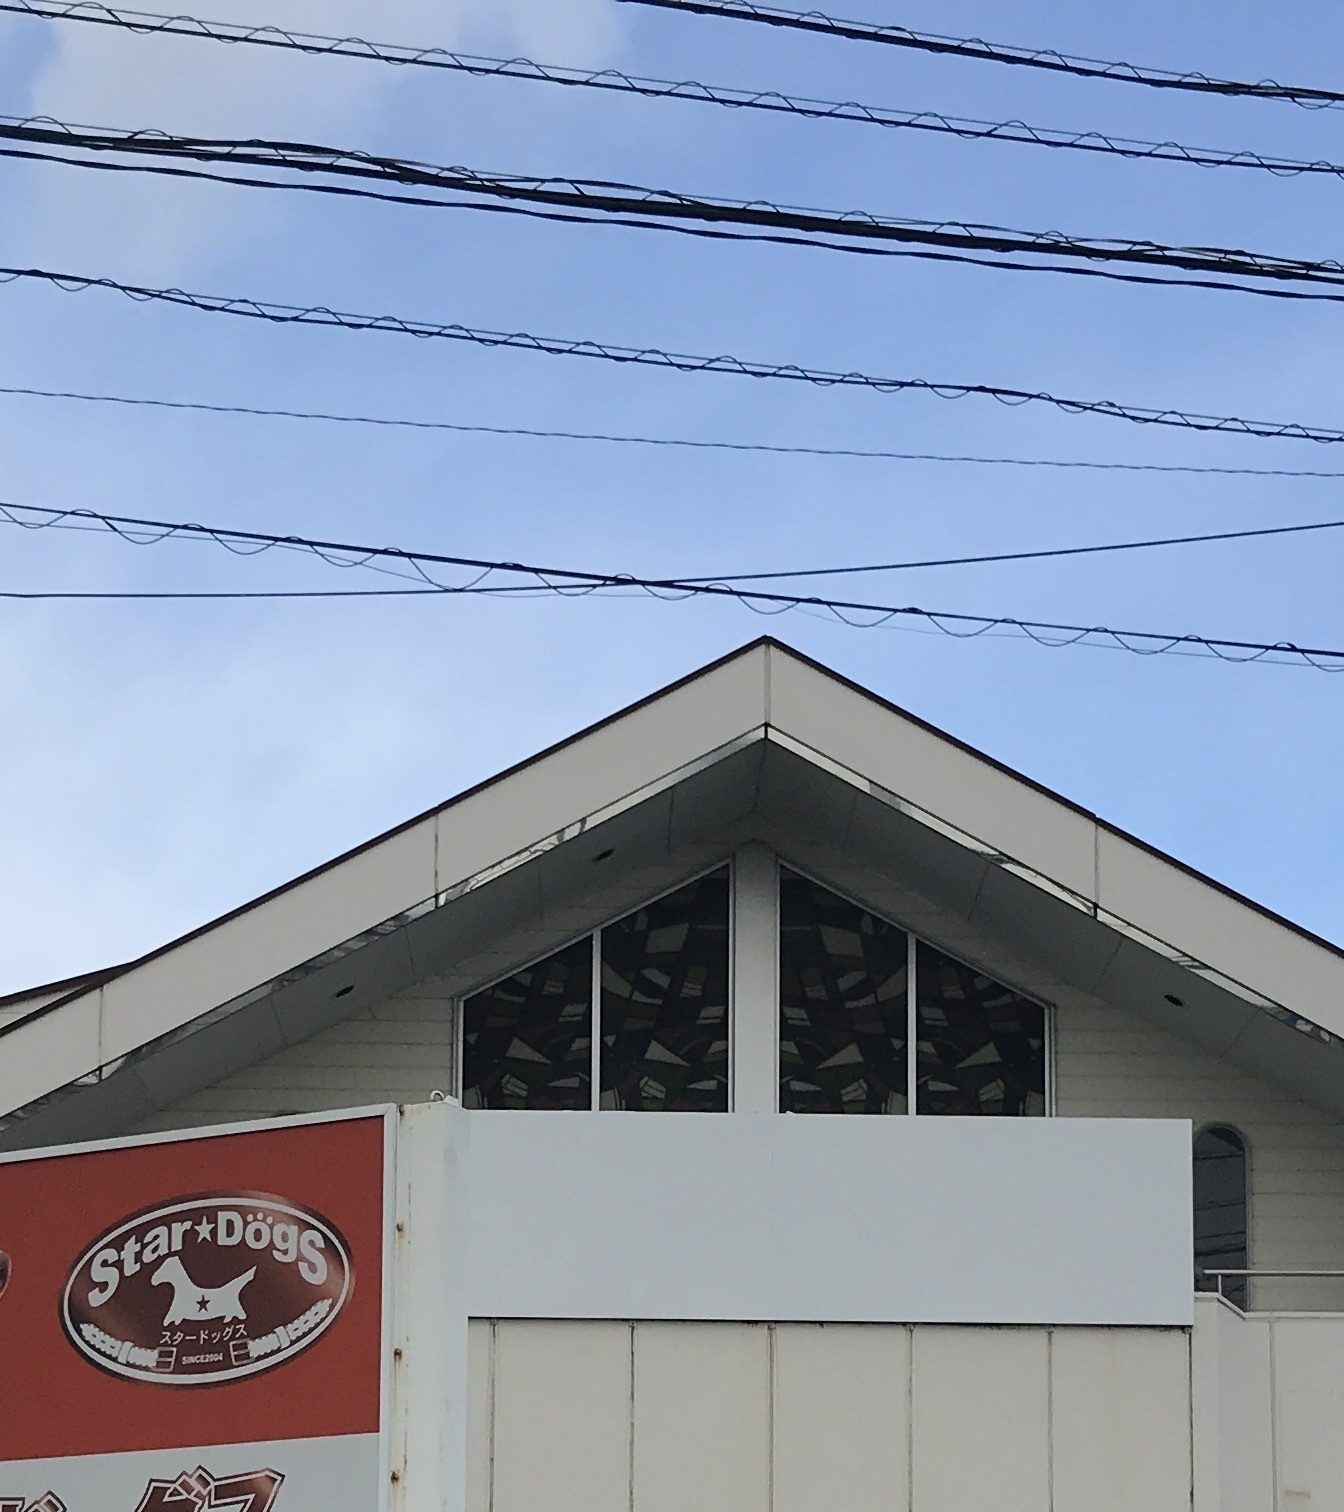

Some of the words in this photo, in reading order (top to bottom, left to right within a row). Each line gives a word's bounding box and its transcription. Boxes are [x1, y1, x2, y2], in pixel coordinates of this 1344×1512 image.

[160, 1324, 248, 1345] スタードッグス
